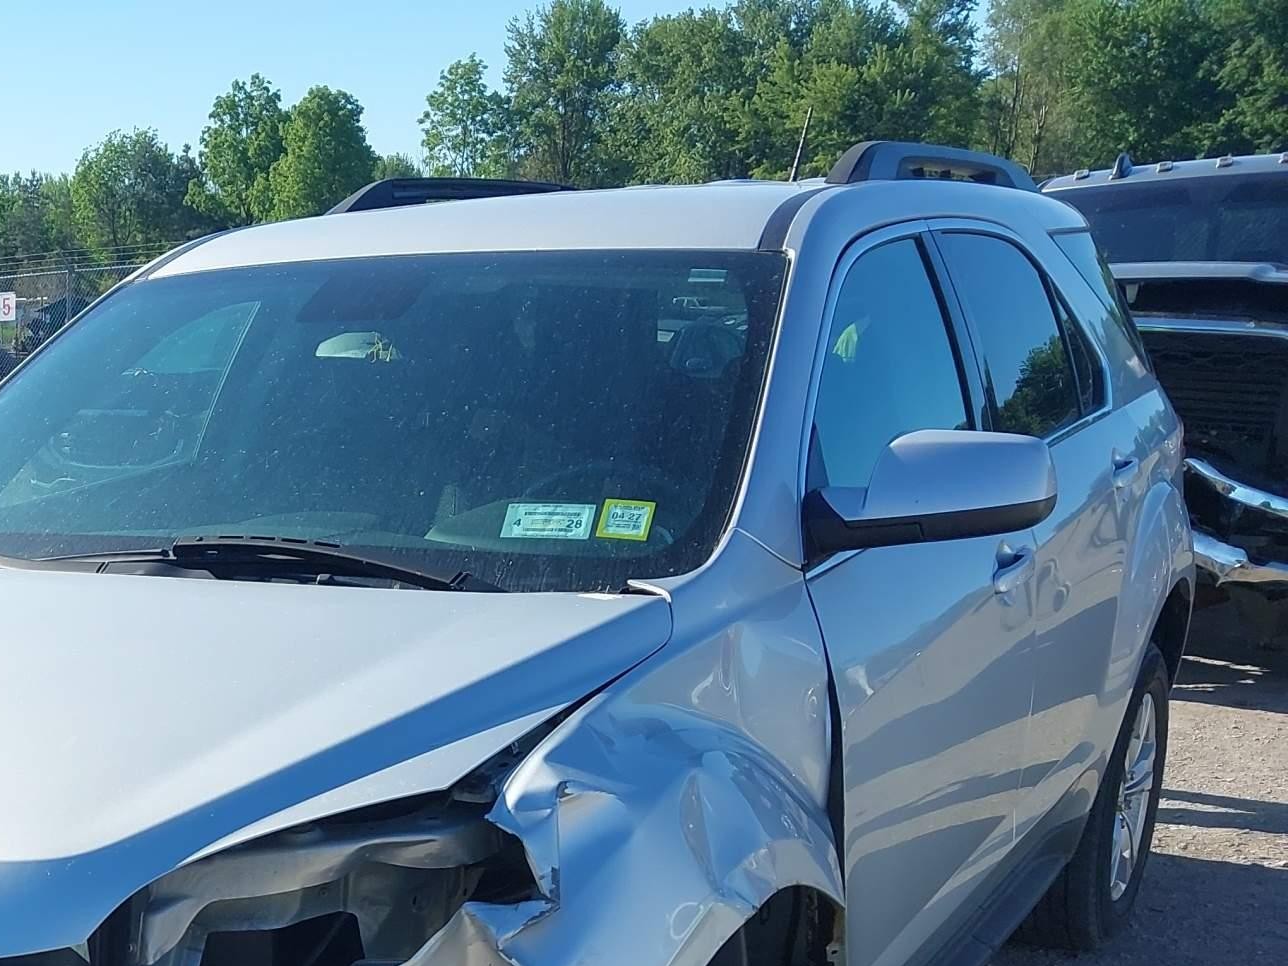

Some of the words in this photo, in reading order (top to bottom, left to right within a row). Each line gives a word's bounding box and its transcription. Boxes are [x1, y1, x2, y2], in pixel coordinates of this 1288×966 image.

[2, 297, 11, 316] 5
[628, 512, 642, 521] 27
[513, 518, 522, 528] 4
[566, 519, 583, 529] 28
